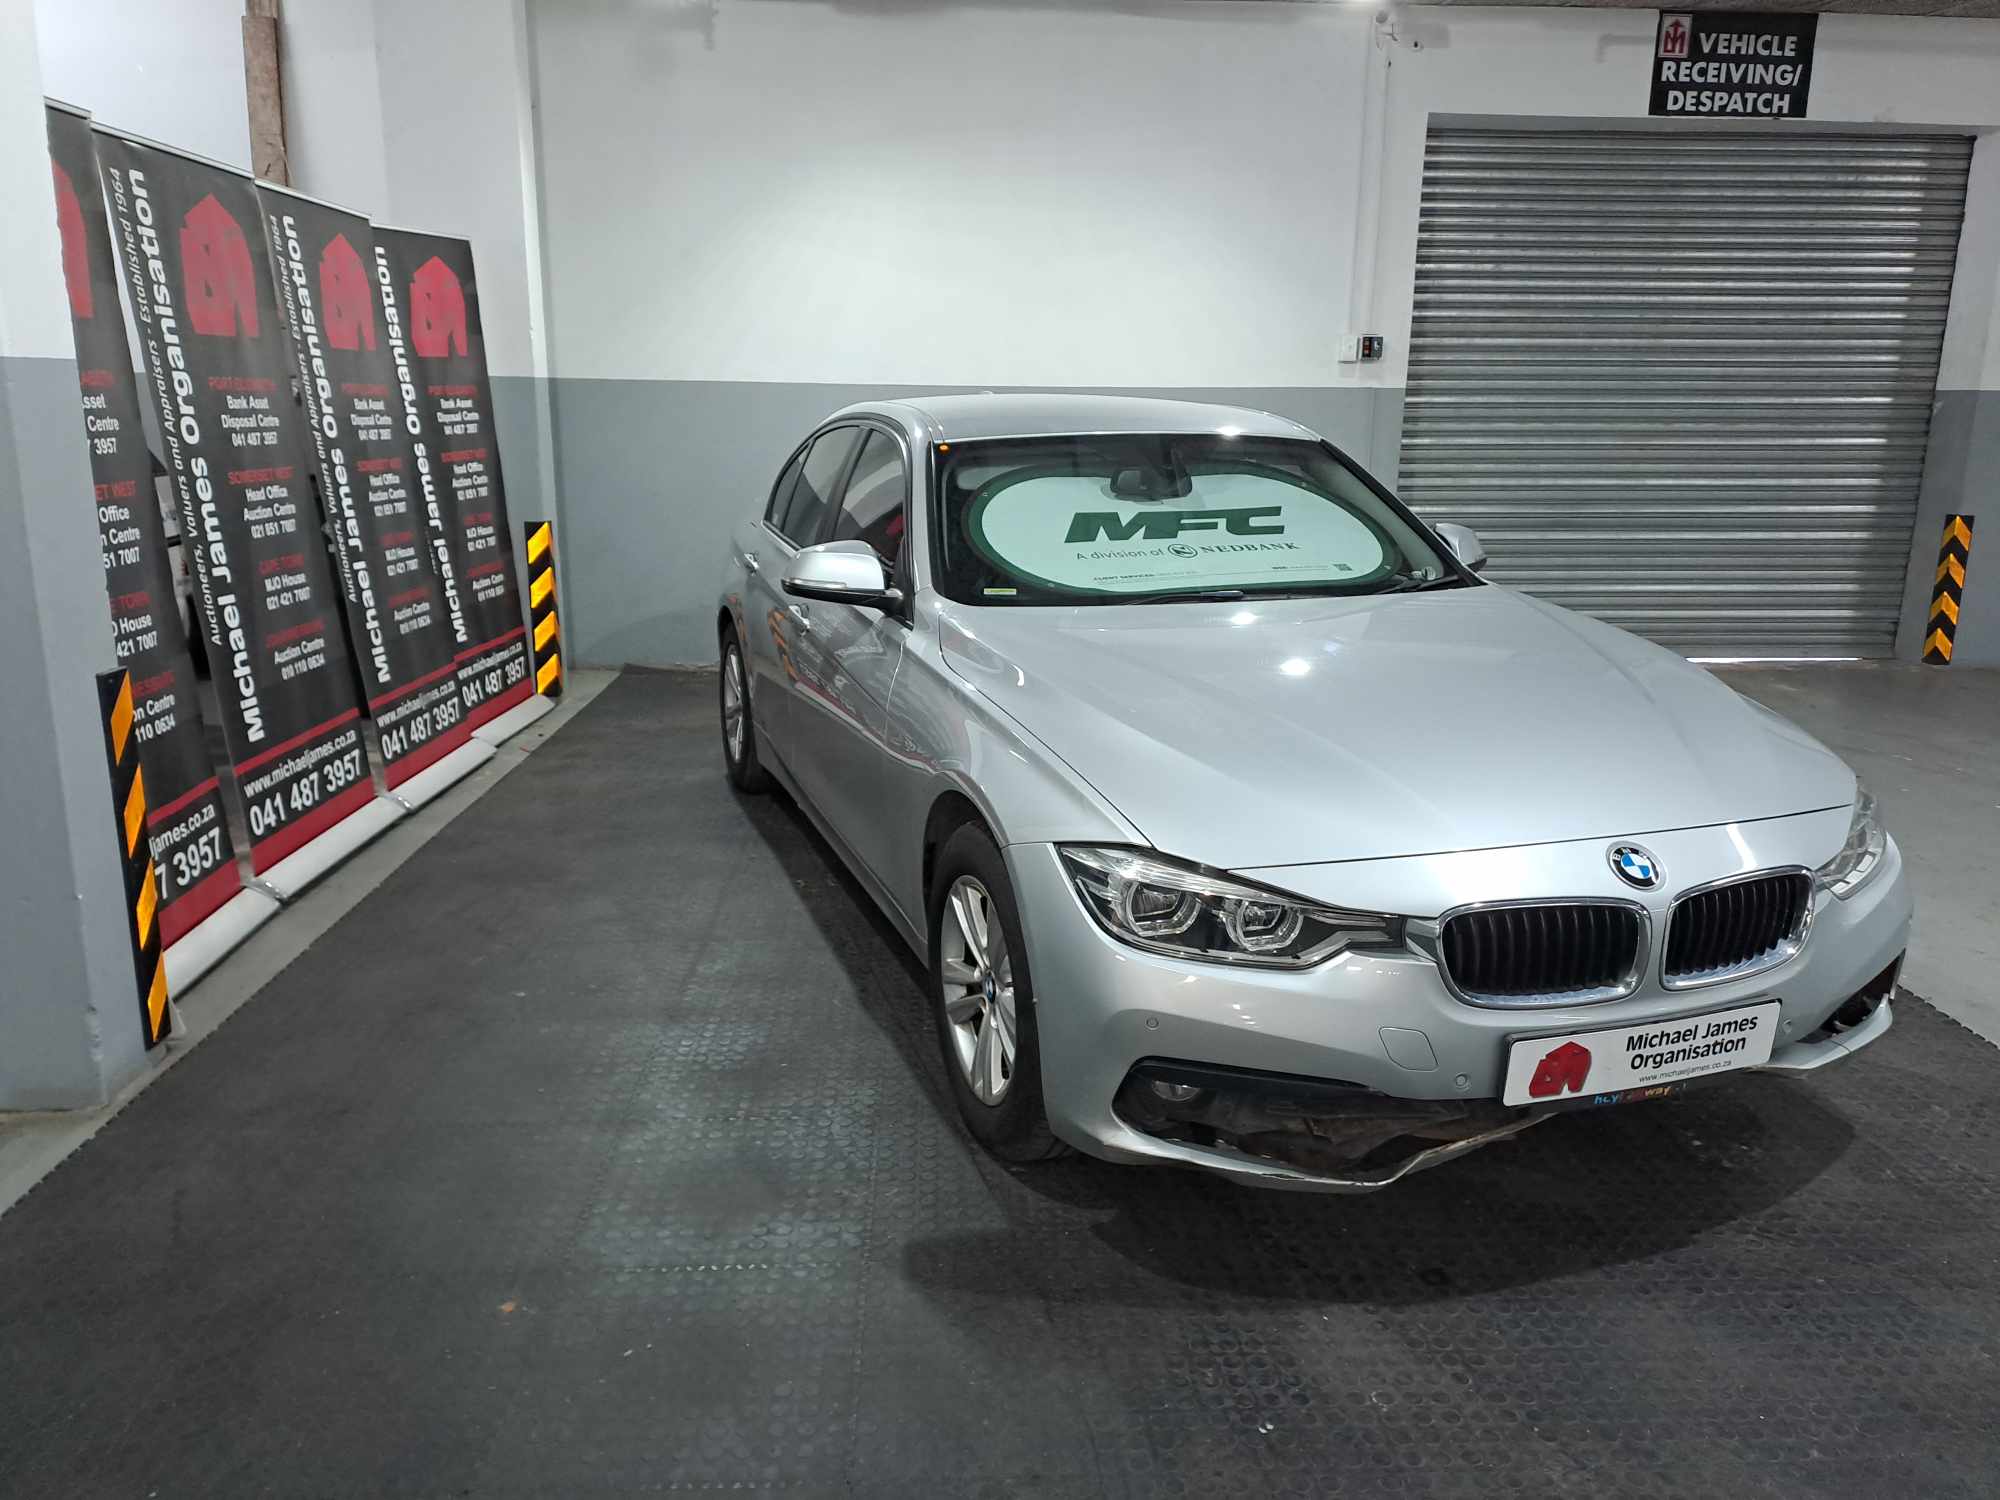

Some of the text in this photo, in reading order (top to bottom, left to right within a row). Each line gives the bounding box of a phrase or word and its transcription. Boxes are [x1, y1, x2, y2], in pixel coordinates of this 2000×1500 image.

[1700, 33, 1797, 57] VEHICLE
[1661, 61, 1803, 86] RECEIVING/
[1666, 90, 1791, 114] DESPATCH
[109, 167, 128, 214] 1964
[119, 217, 152, 323] Established
[276, 255, 301, 340] Established
[374, 246, 422, 435] Organisation
[147, 338, 176, 434] Appraisers
[87, 415, 120, 432] Centre
[221, 413, 279, 430] Disposal Centre
[94, 438, 117, 455] 3957
[129, 169, 265, 743] Michael James Organisation
[166, 435, 184, 470] and
[282, 215, 392, 683] Michael James Organisation
[312, 430, 326, 459] and
[266, 484, 288, 500] Office
[414, 442, 443, 531] James
[100, 505, 130, 523] Office
[178, 475, 198, 537] Valuers
[243, 506, 273, 521] Auction
[109, 527, 141, 545] Centre
[1064, 506, 1285, 543] MFC
[118, 547, 140, 566] 7007
[1076, 542, 1301, 560] A division of NEDBANK
[281, 572, 306, 587] House
[433, 538, 468, 643] Michael
[119, 614, 152, 634] House
[116, 640, 135, 658] 421
[461, 655, 525, 708] 041 487 3957
[146, 694, 176, 716] Centre
[381, 695, 460, 759] 041 487 3957
[243, 729, 357, 798] www.michaeljames.co.za
[249, 748, 361, 836] 041 487 3957
[173, 826, 220, 886] 3957
[1626, 1015, 1758, 1052] Michael James
[1630, 1036, 1746, 1070] Organisation
